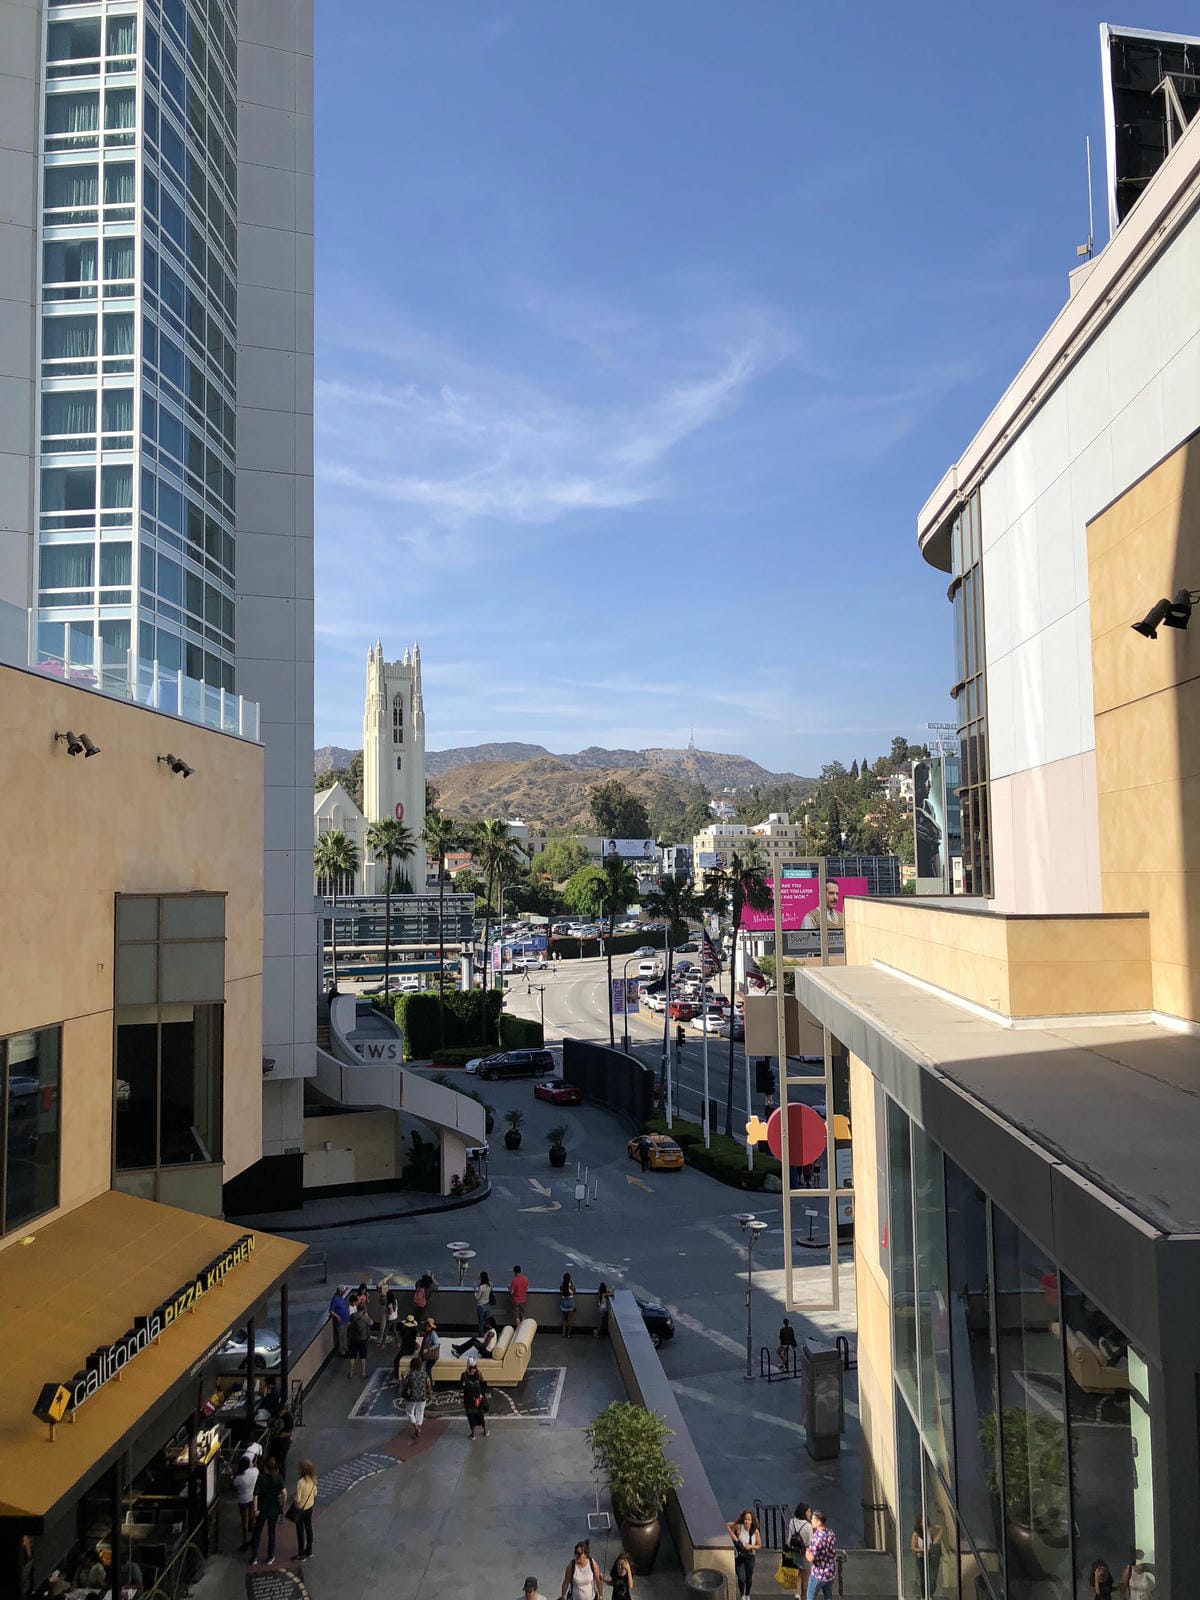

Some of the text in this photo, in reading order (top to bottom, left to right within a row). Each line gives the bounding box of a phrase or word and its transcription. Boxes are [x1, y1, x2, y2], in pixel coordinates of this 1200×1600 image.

[74, 1234, 256, 1407] california PIZZA KITCHEN
